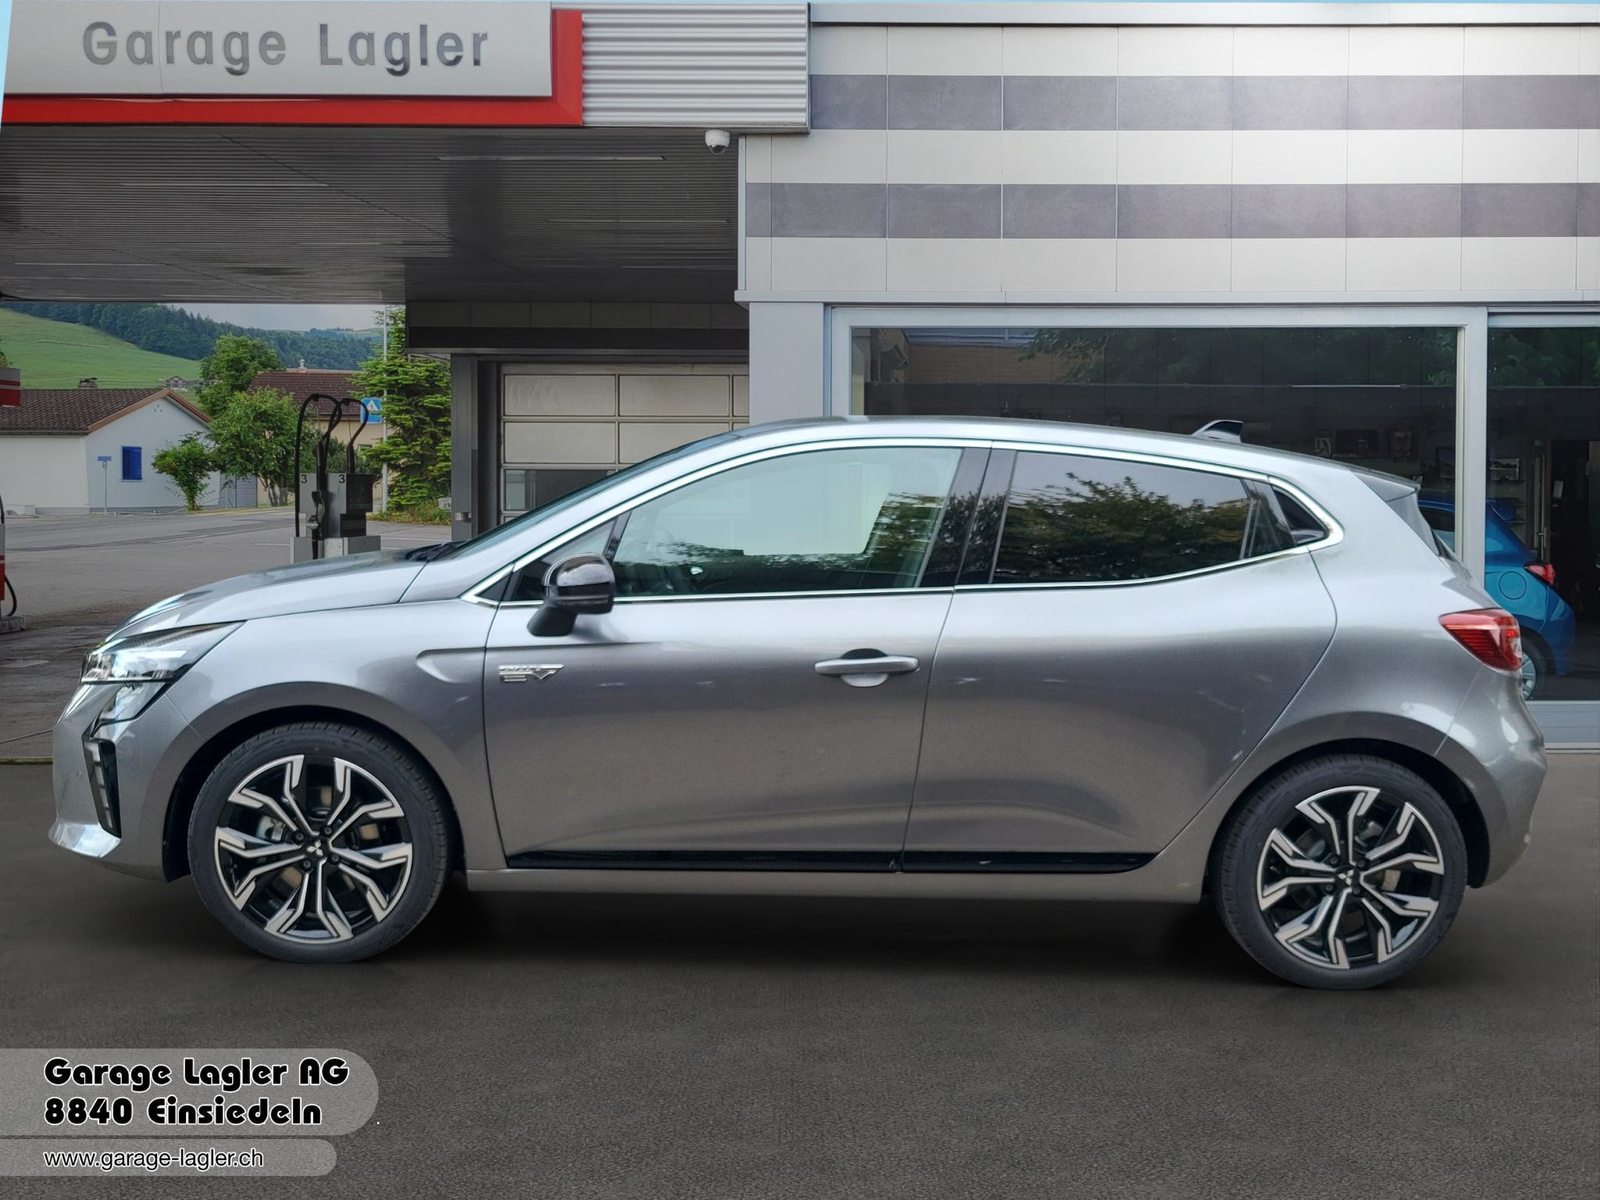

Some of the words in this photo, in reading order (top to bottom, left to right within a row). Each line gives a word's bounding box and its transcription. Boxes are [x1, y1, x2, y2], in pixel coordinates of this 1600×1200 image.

[82, 21, 287, 76] Garage
[318, 23, 489, 77] Lagler
[300, 474, 308, 484] 3
[338, 474, 346, 484] 3
